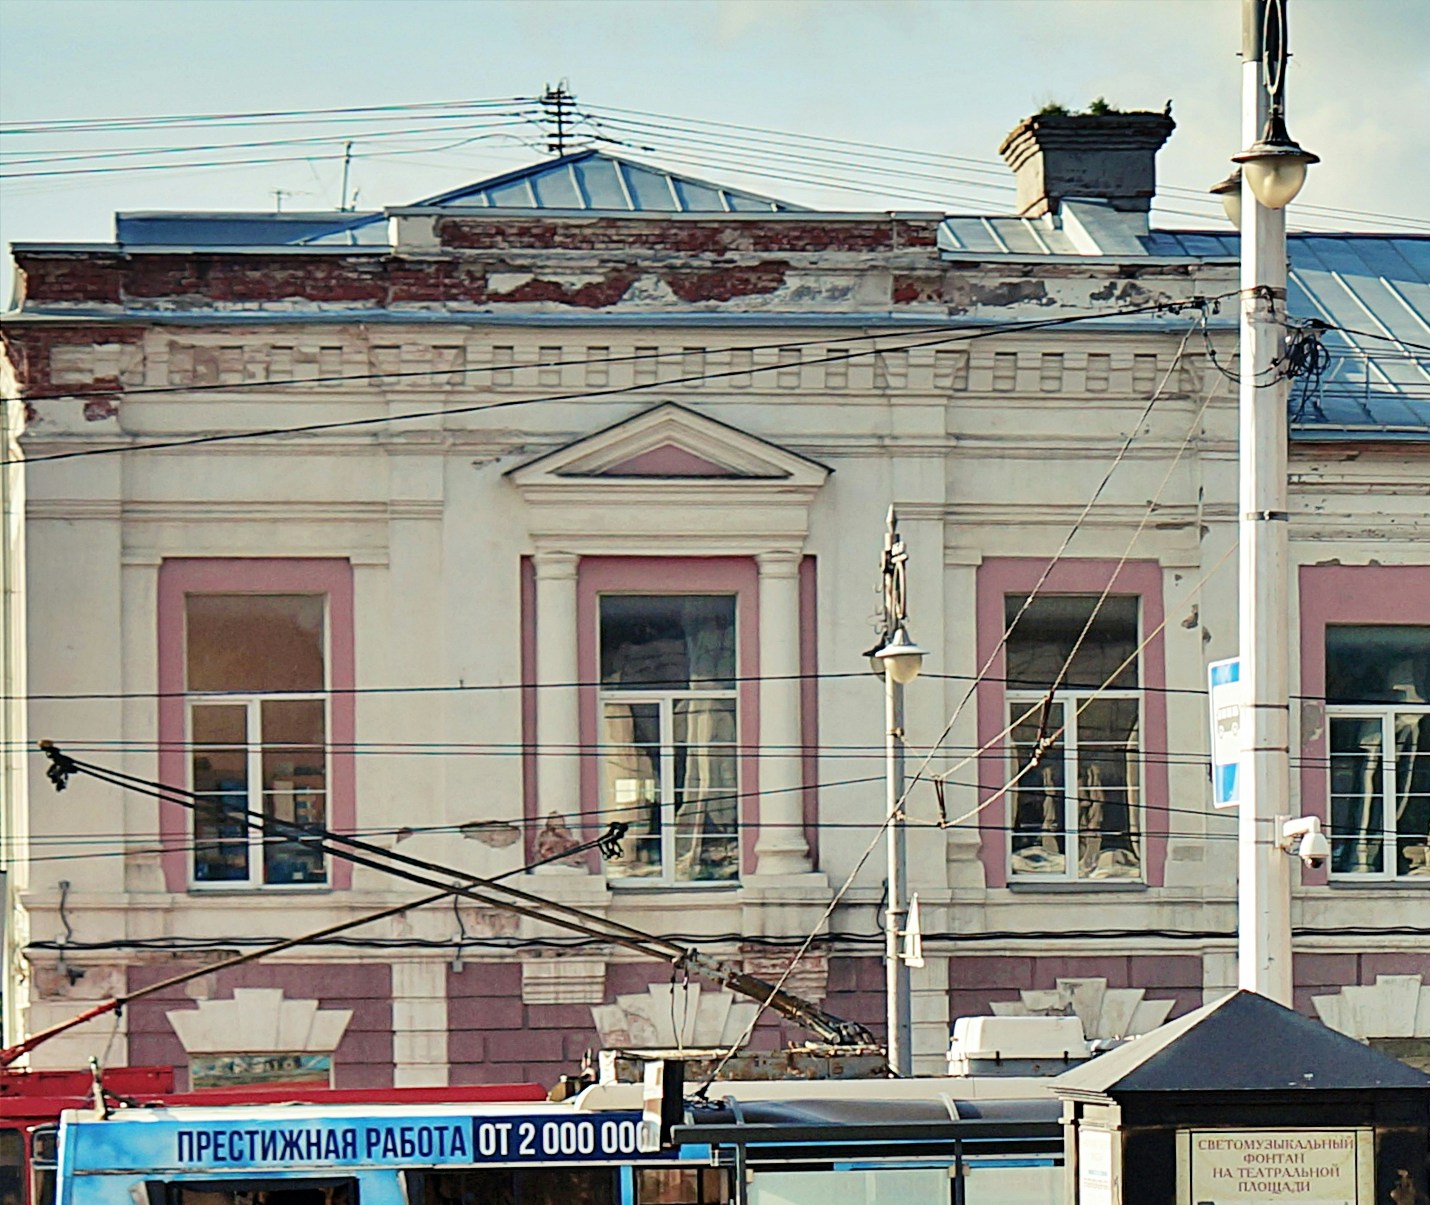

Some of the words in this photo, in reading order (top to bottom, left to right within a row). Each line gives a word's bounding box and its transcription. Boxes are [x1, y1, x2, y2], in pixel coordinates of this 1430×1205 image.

[177, 1128, 357, 1162] ПРЕСТИЖНАЯ
[365, 1124, 467, 1160] РАБОТА
[479, 1122, 513, 1157] ОТ
[519, 1121, 535, 1155] 2
[542, 1121, 594, 1154] 000
[1198, 1135, 1354, 1150] СВЕТОМУЗЫКАЛЬНЫЙ
[1243, 1153, 1305, 1164] ФОНТАН
[1212, 1168, 1232, 1179] НА
[1237, 1164, 1340, 1179] ТЕАТРАЛЬНОЙ
[1238, 1181, 1310, 1194] ПЛОЩАДИ
